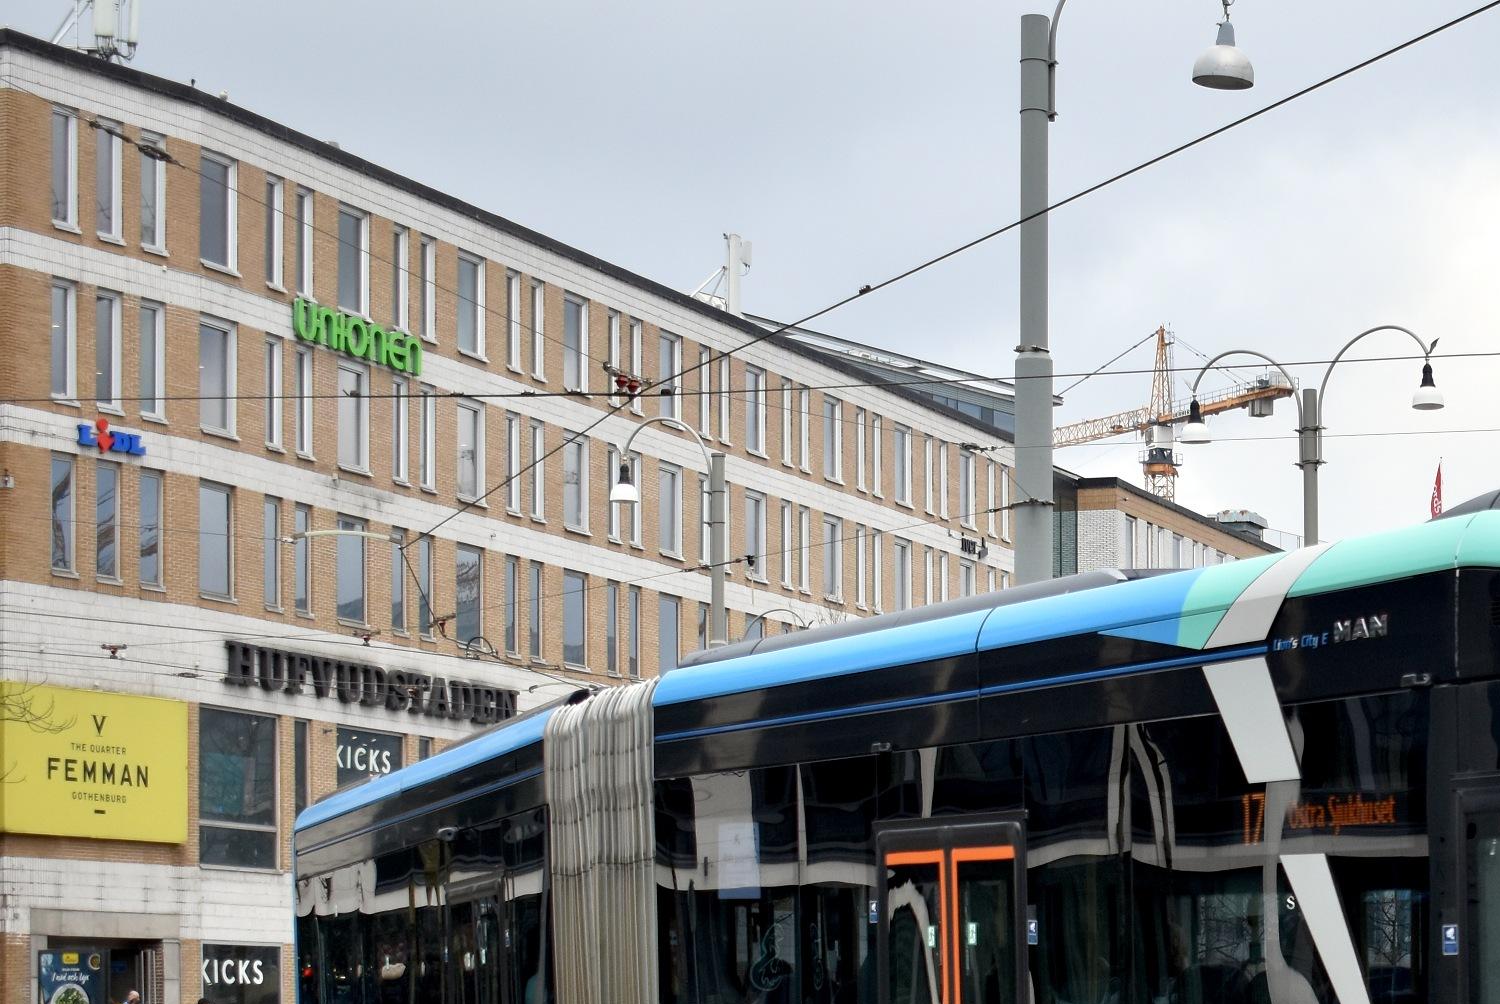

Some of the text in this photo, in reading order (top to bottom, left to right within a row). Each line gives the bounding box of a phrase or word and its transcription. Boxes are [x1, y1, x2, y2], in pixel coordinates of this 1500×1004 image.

[1321, 632, 1329, 645] E
[1333, 614, 1388, 643] MAN
[223, 640, 520, 725] HUFVUDSTADEN
[71, 742, 127, 755] THE QUARTER
[47, 756, 149, 788] FEMMAN
[71, 791, 127, 804] GOTHENBURG
[1242, 791, 1266, 846] 17
